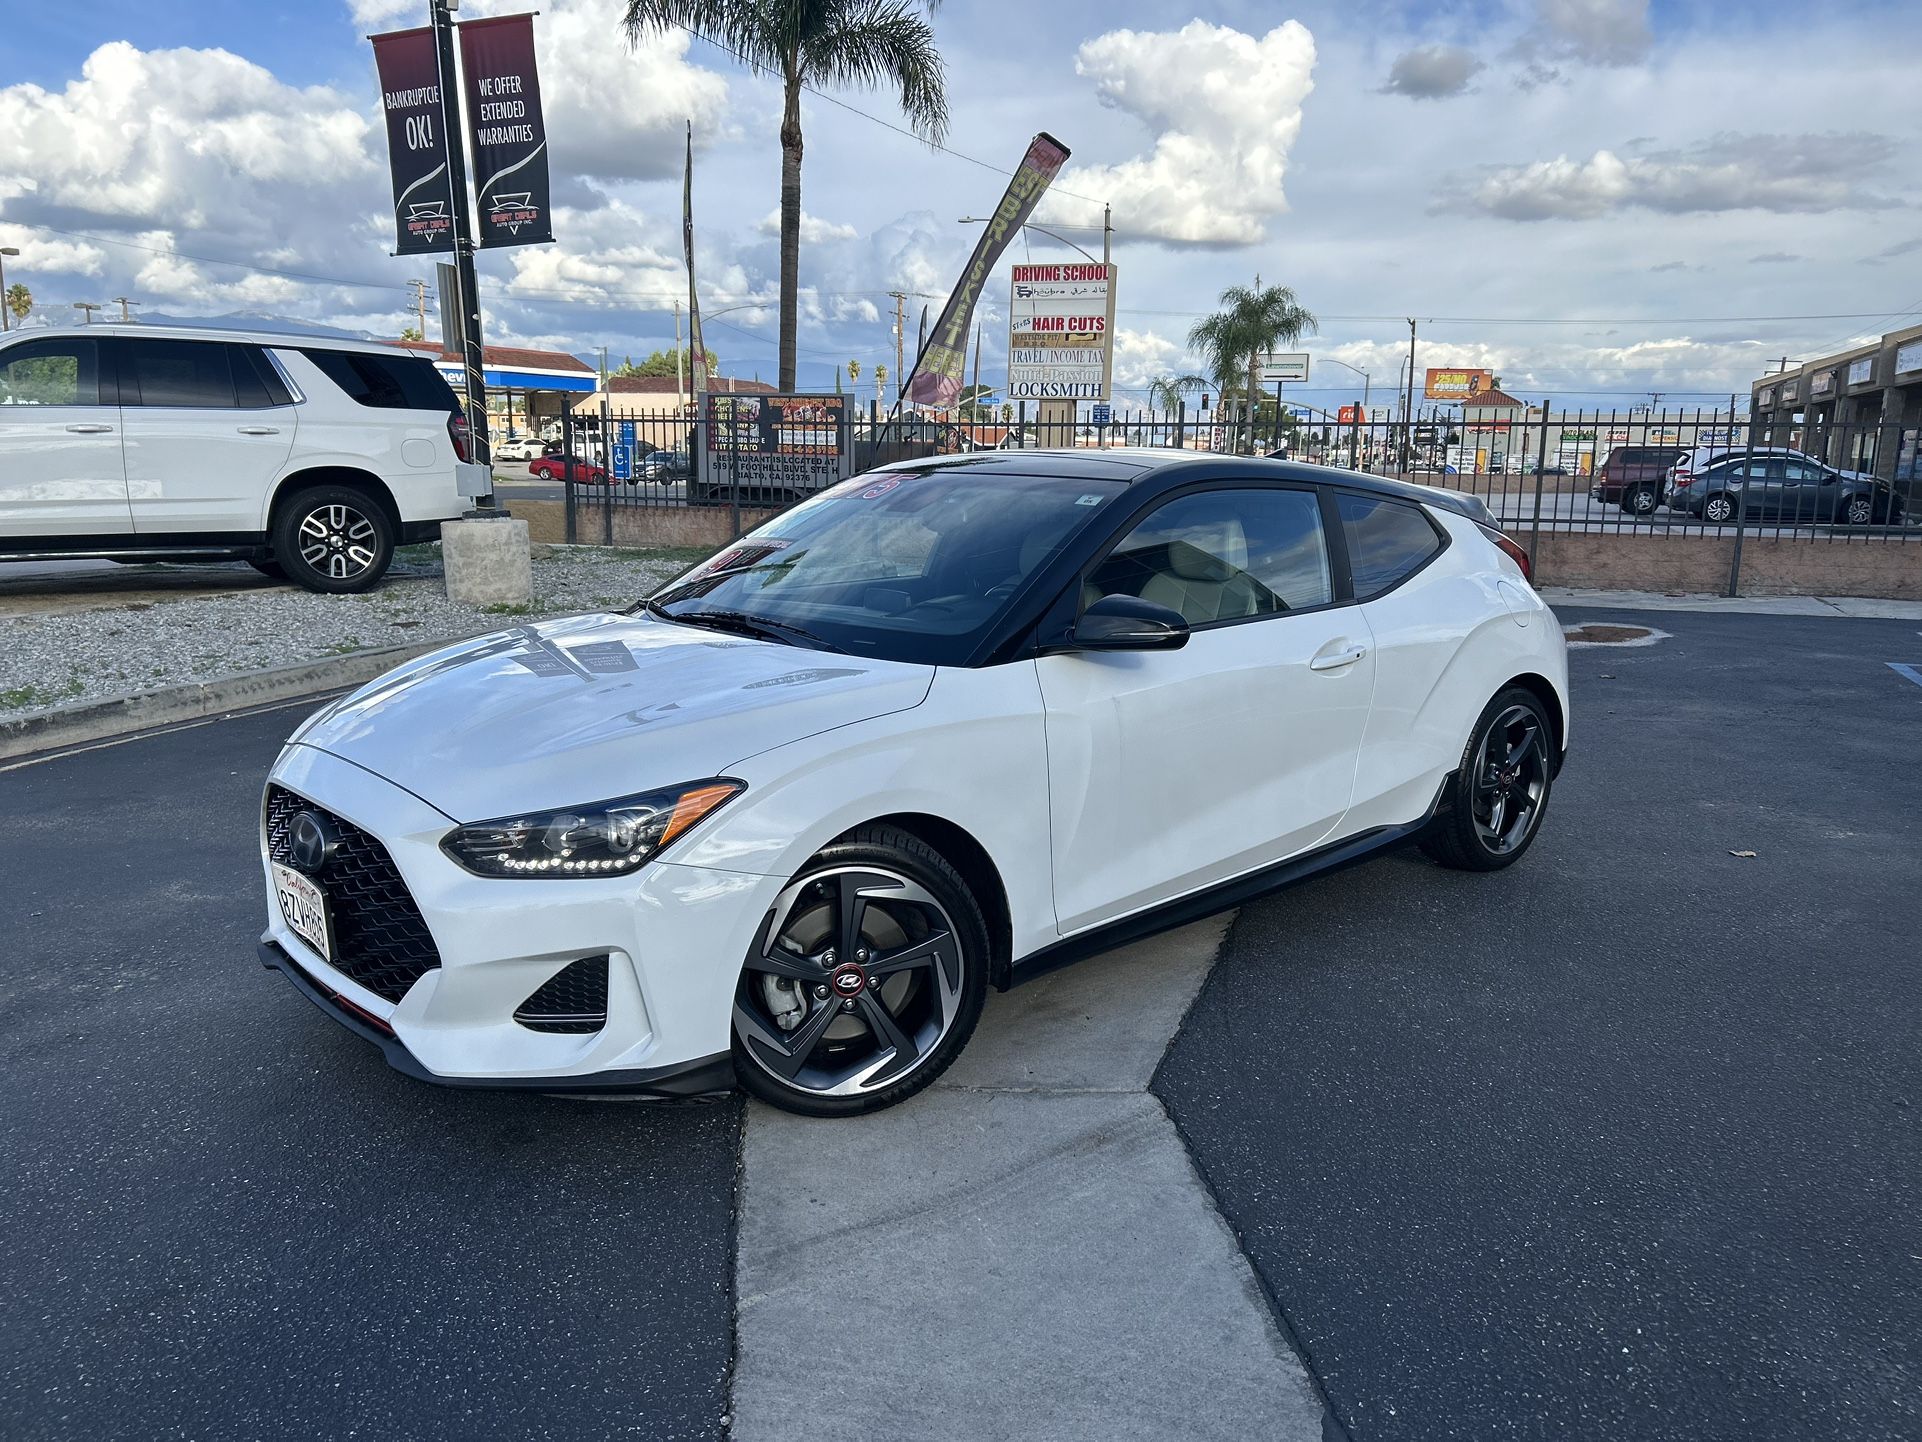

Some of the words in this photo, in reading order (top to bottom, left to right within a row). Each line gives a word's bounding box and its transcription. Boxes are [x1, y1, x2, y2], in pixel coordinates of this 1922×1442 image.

[478, 78, 492, 97] WE
[494, 75, 522, 95] OFFER
[385, 86, 440, 110] BANKRUPTCIE
[481, 101, 525, 121] EXTENDED
[405, 114, 434, 151] OK!
[478, 125, 533, 146] WARRANTIES
[943, 195, 1023, 346] BRISKET
[1013, 267, 1061, 282] DRIVING
[1063, 265, 1109, 281] SCHOOL
[1032, 317, 1064, 331] HAIR
[1068, 316, 1105, 331] CUTS
[1086, 350, 1105, 363] TAX
[1010, 382, 1103, 397] LOCKSMITH
[717, 454, 770, 463] RESAURANT
[741, 463, 781, 472] FOOTHILL
[783, 465, 808, 473] BLVD.
[785, 474, 811, 482] 92376
